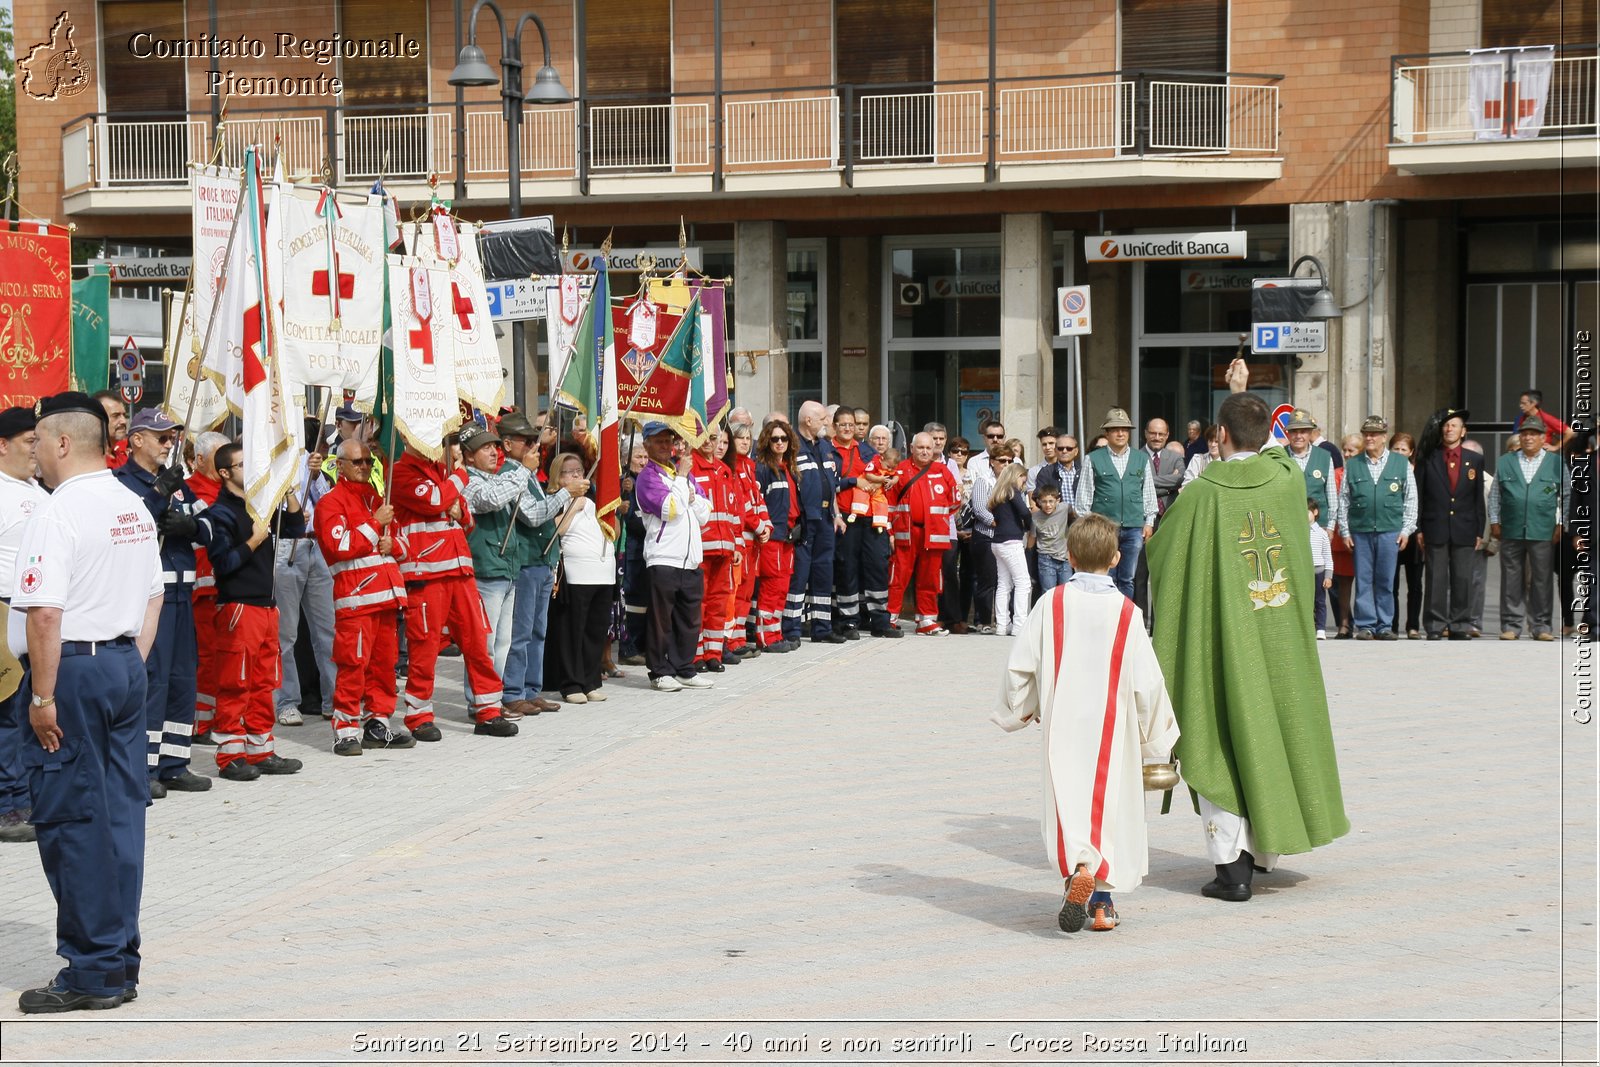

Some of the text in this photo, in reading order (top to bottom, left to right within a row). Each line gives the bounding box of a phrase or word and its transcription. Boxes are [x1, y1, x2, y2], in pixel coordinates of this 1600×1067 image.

[1123, 240, 1229, 256] UniCredit Banca
[7, 235, 67, 283] MUSICALE
[120, 263, 191, 278] UniCredit Ban
[32, 283, 63, 299] SERRA
[955, 280, 1000, 295] UniCred
[1262, 330, 1274, 346] P
[650, 386, 657, 394] DI
[617, 395, 663, 409] ANTENA
